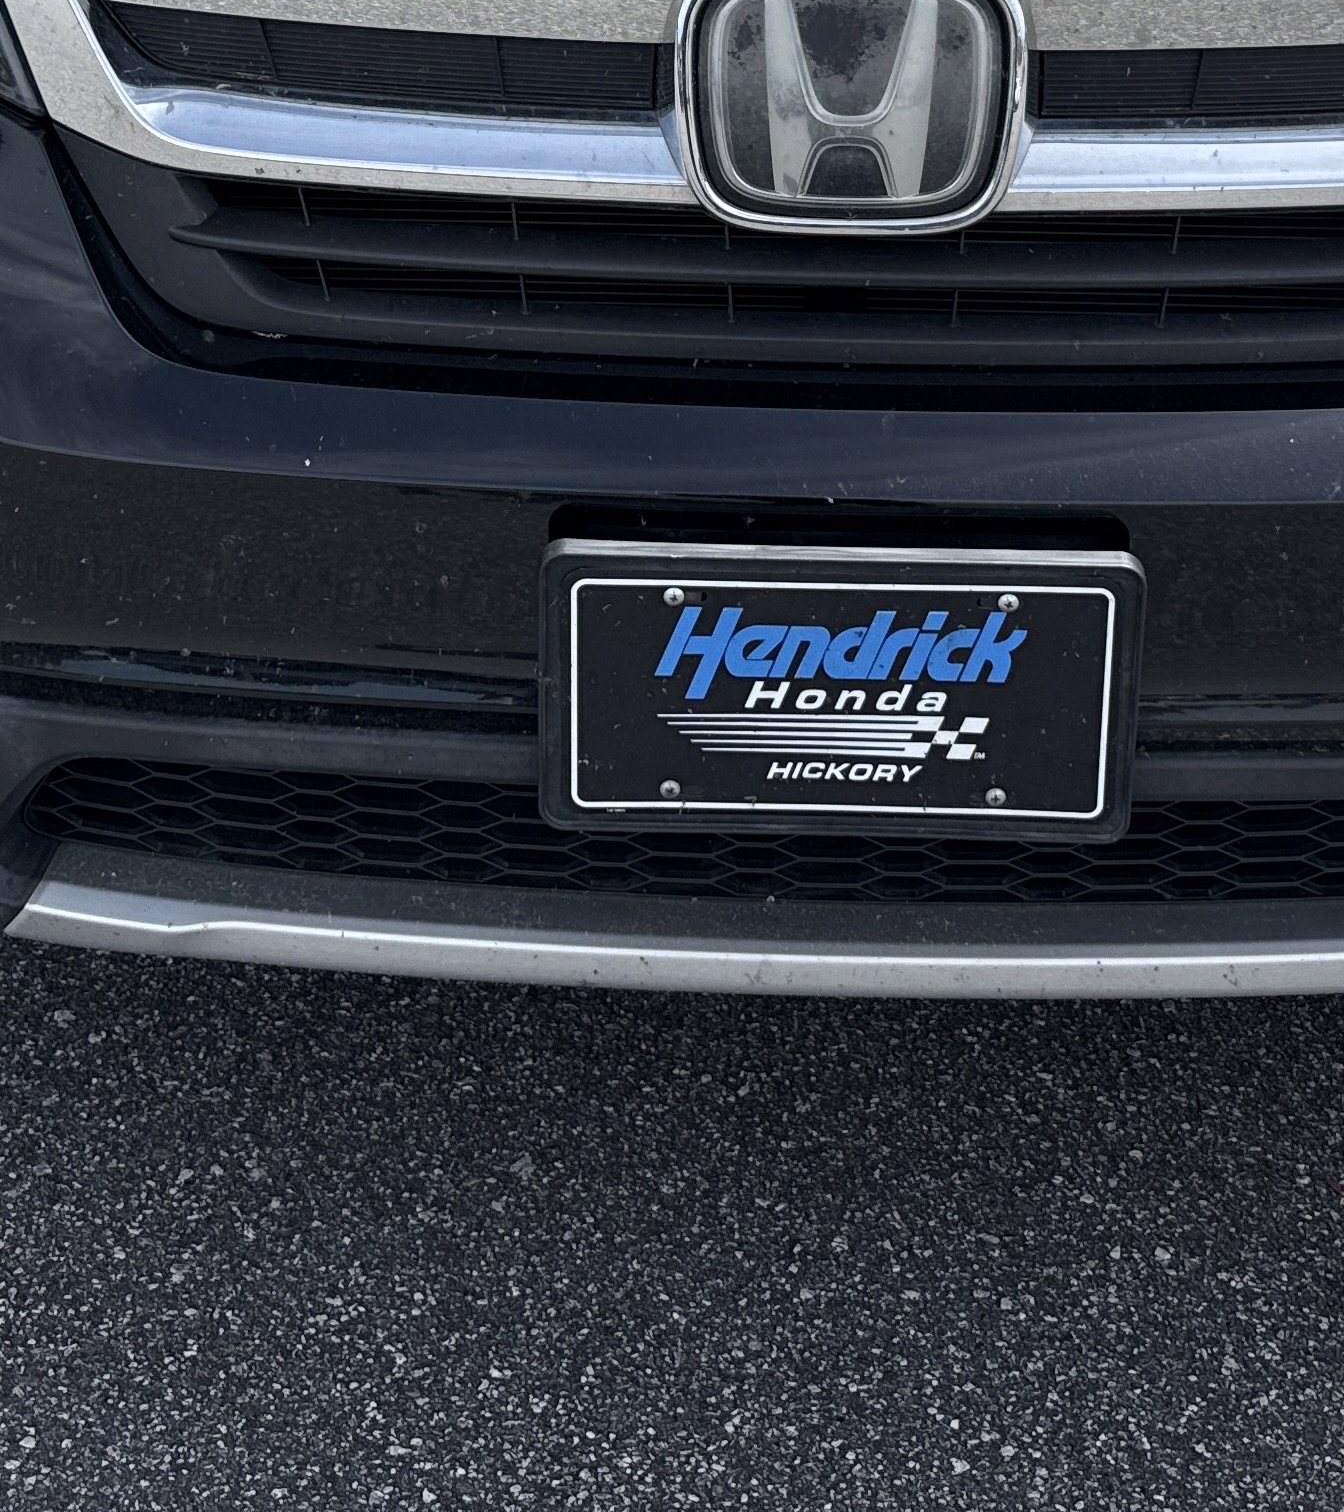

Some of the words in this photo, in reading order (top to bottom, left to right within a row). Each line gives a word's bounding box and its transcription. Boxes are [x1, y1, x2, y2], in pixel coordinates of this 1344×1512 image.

[655, 605, 1029, 700] Hendrick
[744, 680, 948, 714] Honda
[766, 760, 923, 783] HICKORY
